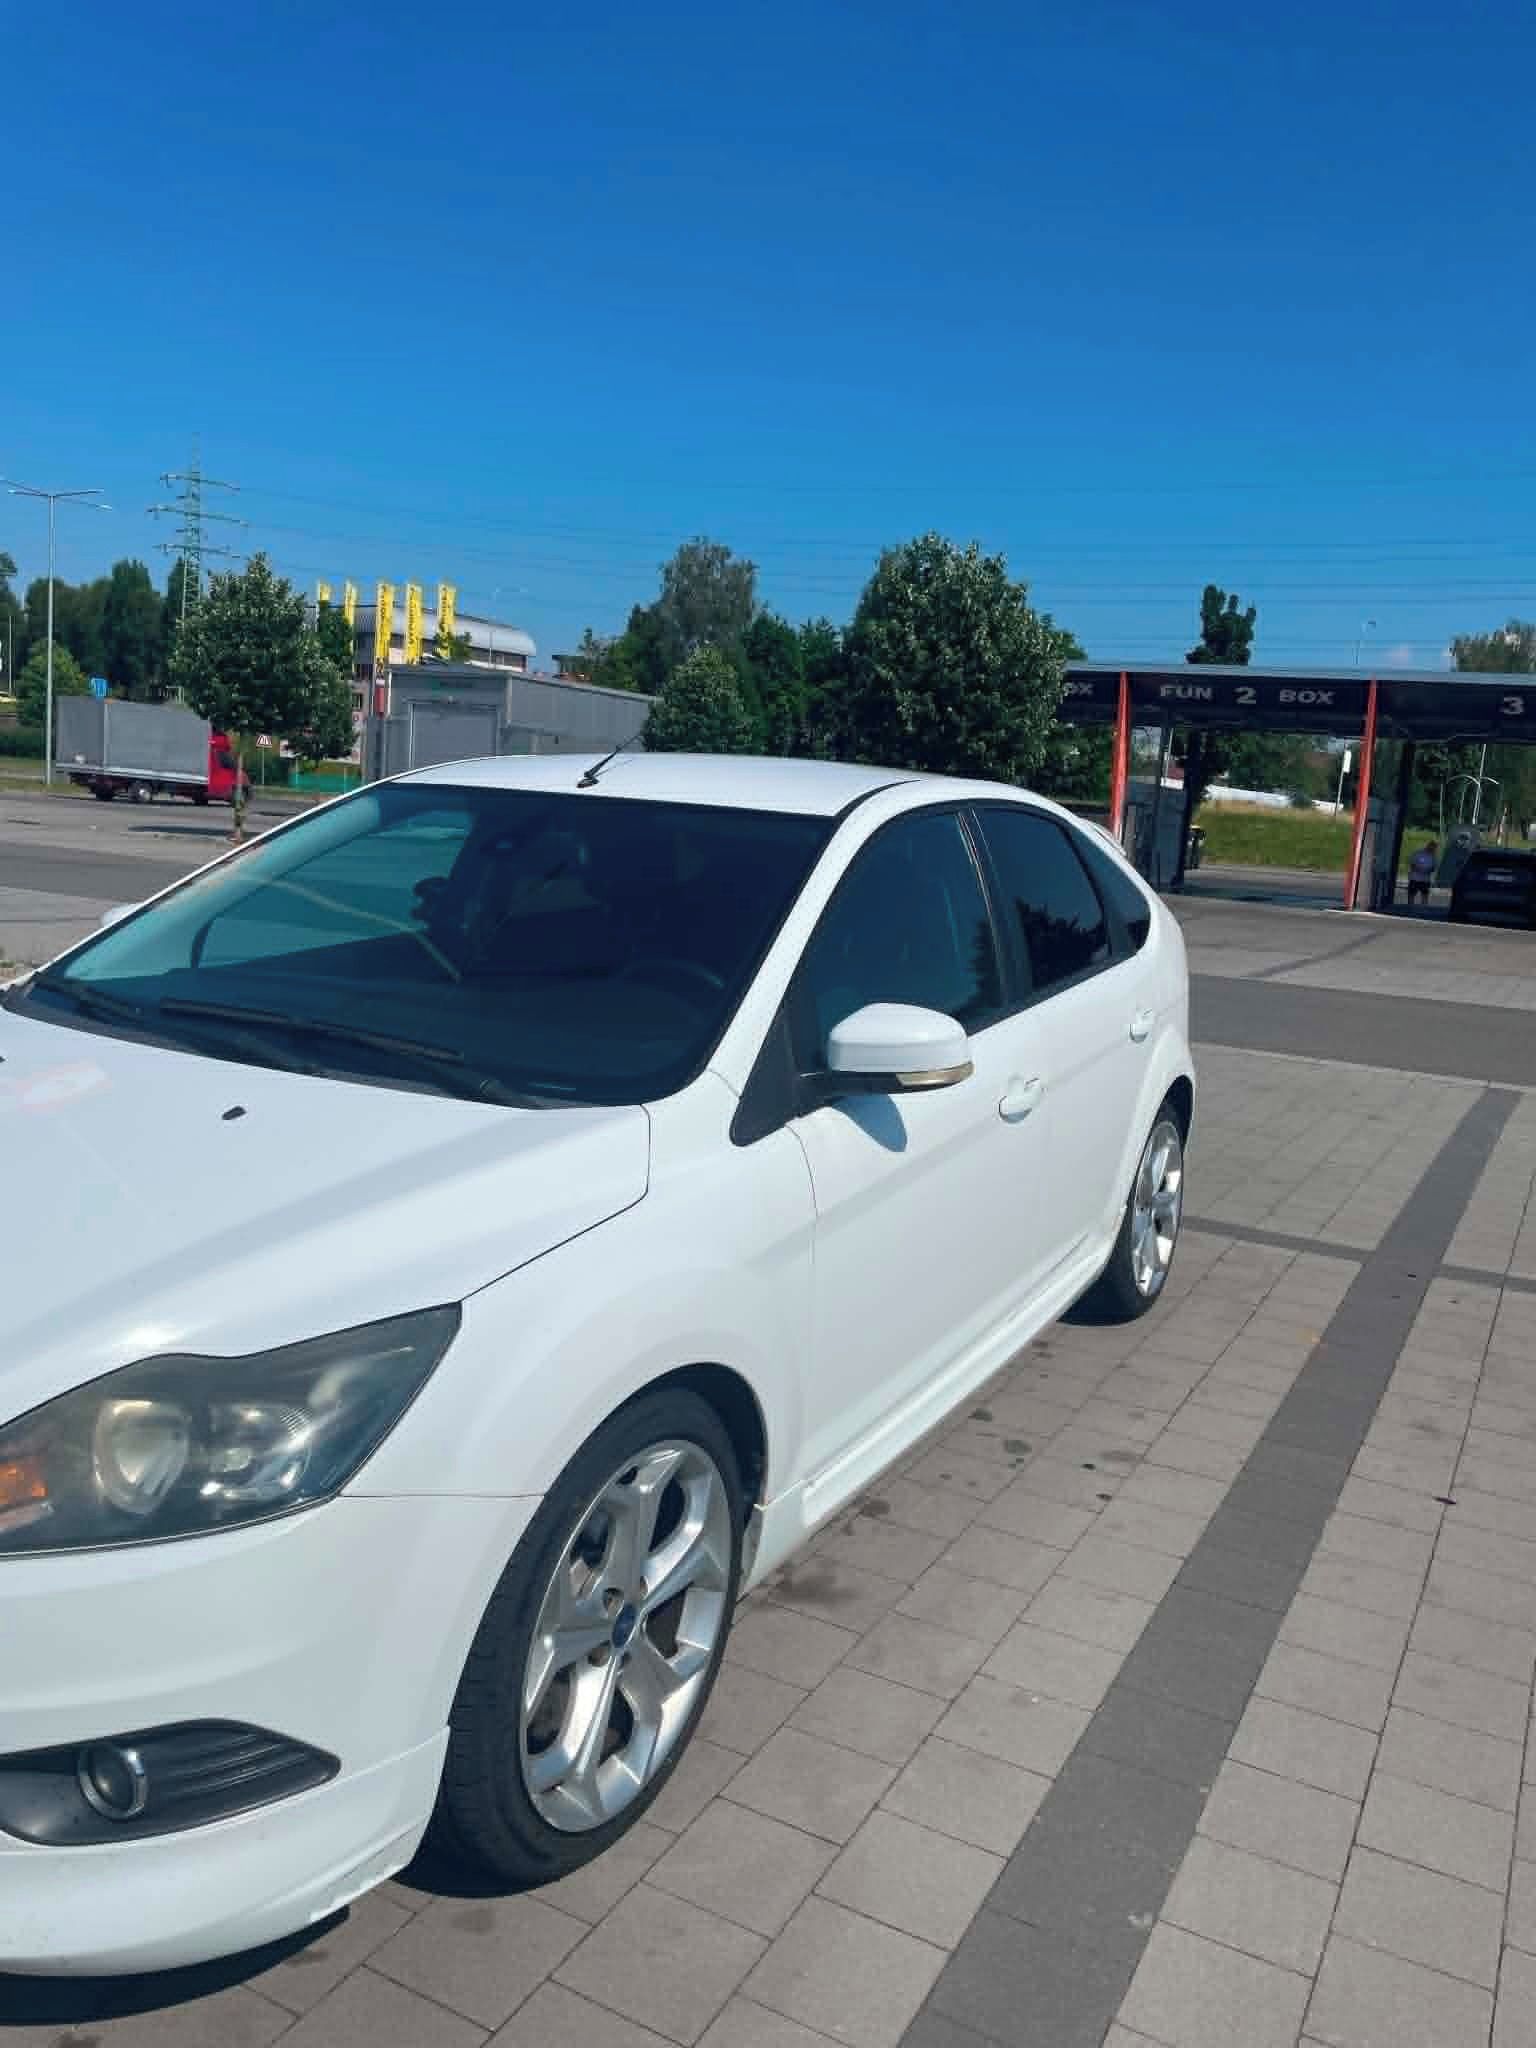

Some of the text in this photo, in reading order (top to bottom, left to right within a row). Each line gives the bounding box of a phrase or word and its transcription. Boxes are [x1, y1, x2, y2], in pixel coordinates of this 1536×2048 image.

[1160, 684, 1336, 705] FUN 2 BOX
[1501, 696, 1525, 715] 3
